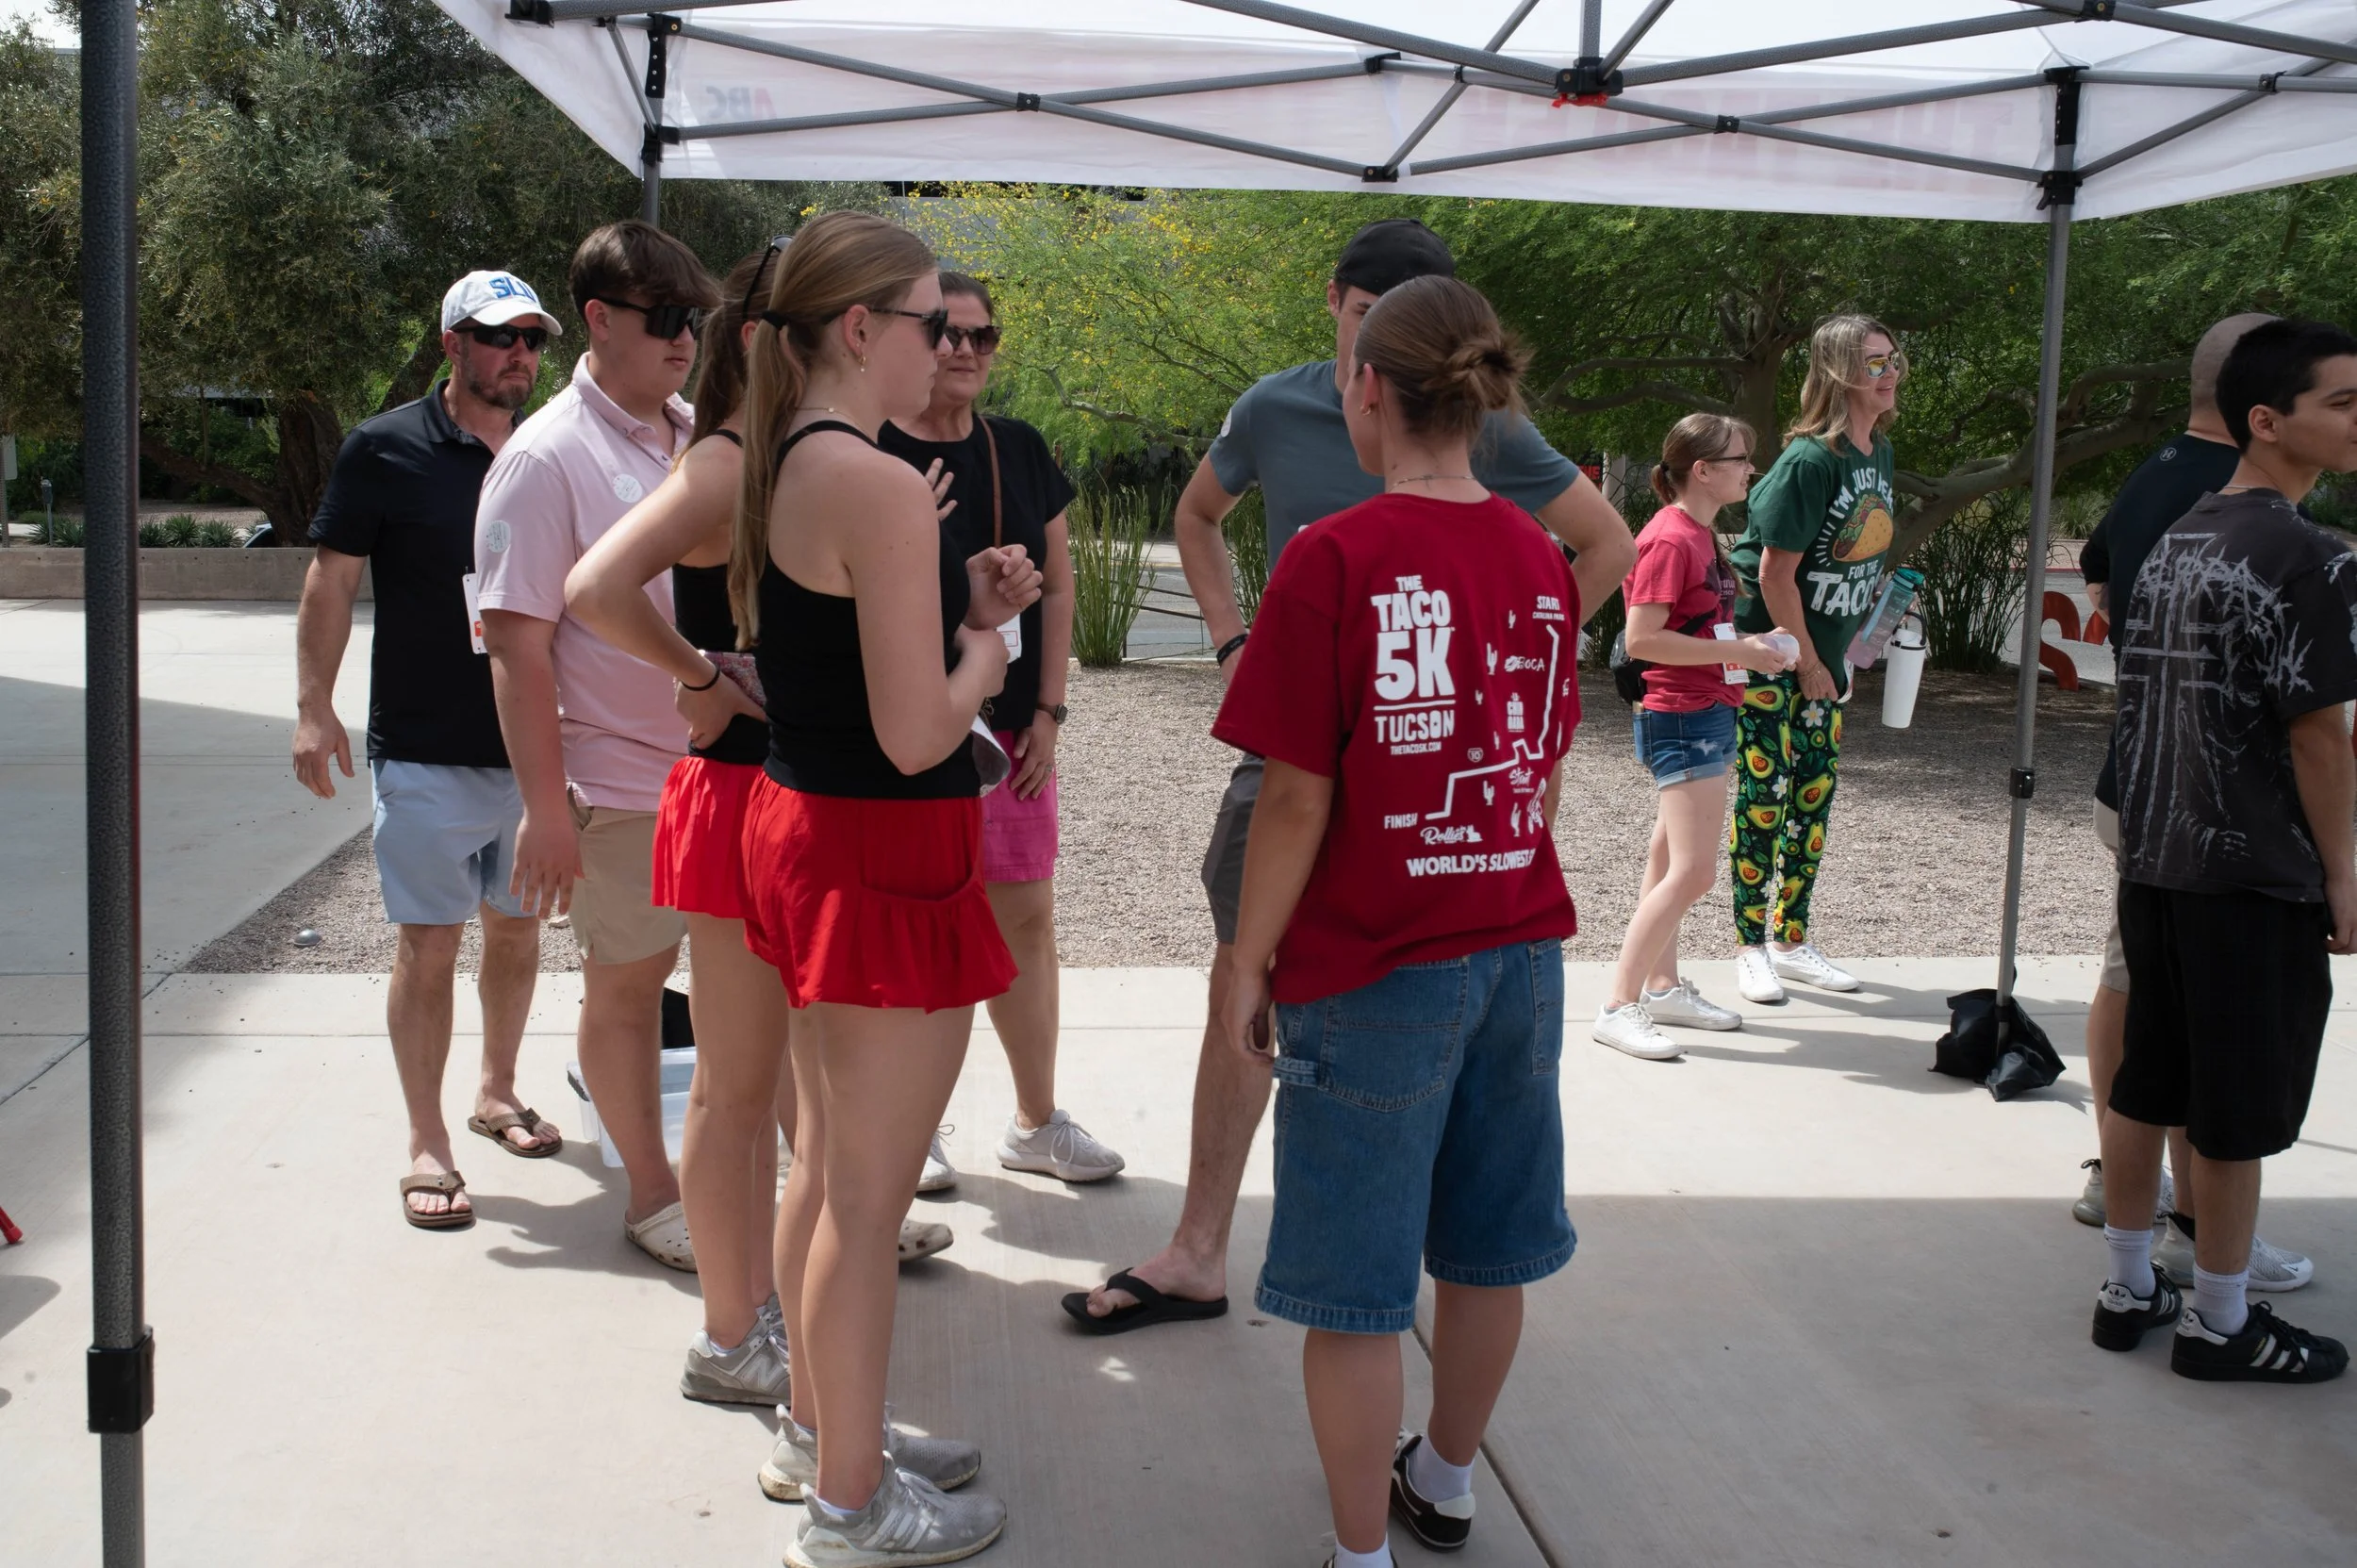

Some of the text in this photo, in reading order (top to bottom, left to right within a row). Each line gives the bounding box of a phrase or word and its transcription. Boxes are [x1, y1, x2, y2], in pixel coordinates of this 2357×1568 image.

[1828, 484, 1854, 520] I'M
[1852, 467, 1876, 495] JUST
[1395, 574, 1424, 592] THE
[1848, 559, 1879, 580] FOR THE
[1370, 589, 1452, 632] TACO
[1374, 626, 1456, 701] 5K
[1374, 709, 1455, 743] TUCSON
[1384, 813, 1418, 830] FINISH
[1406, 853, 1488, 878] WORLD'S
[1488, 849, 1530, 872] SLOWEST
